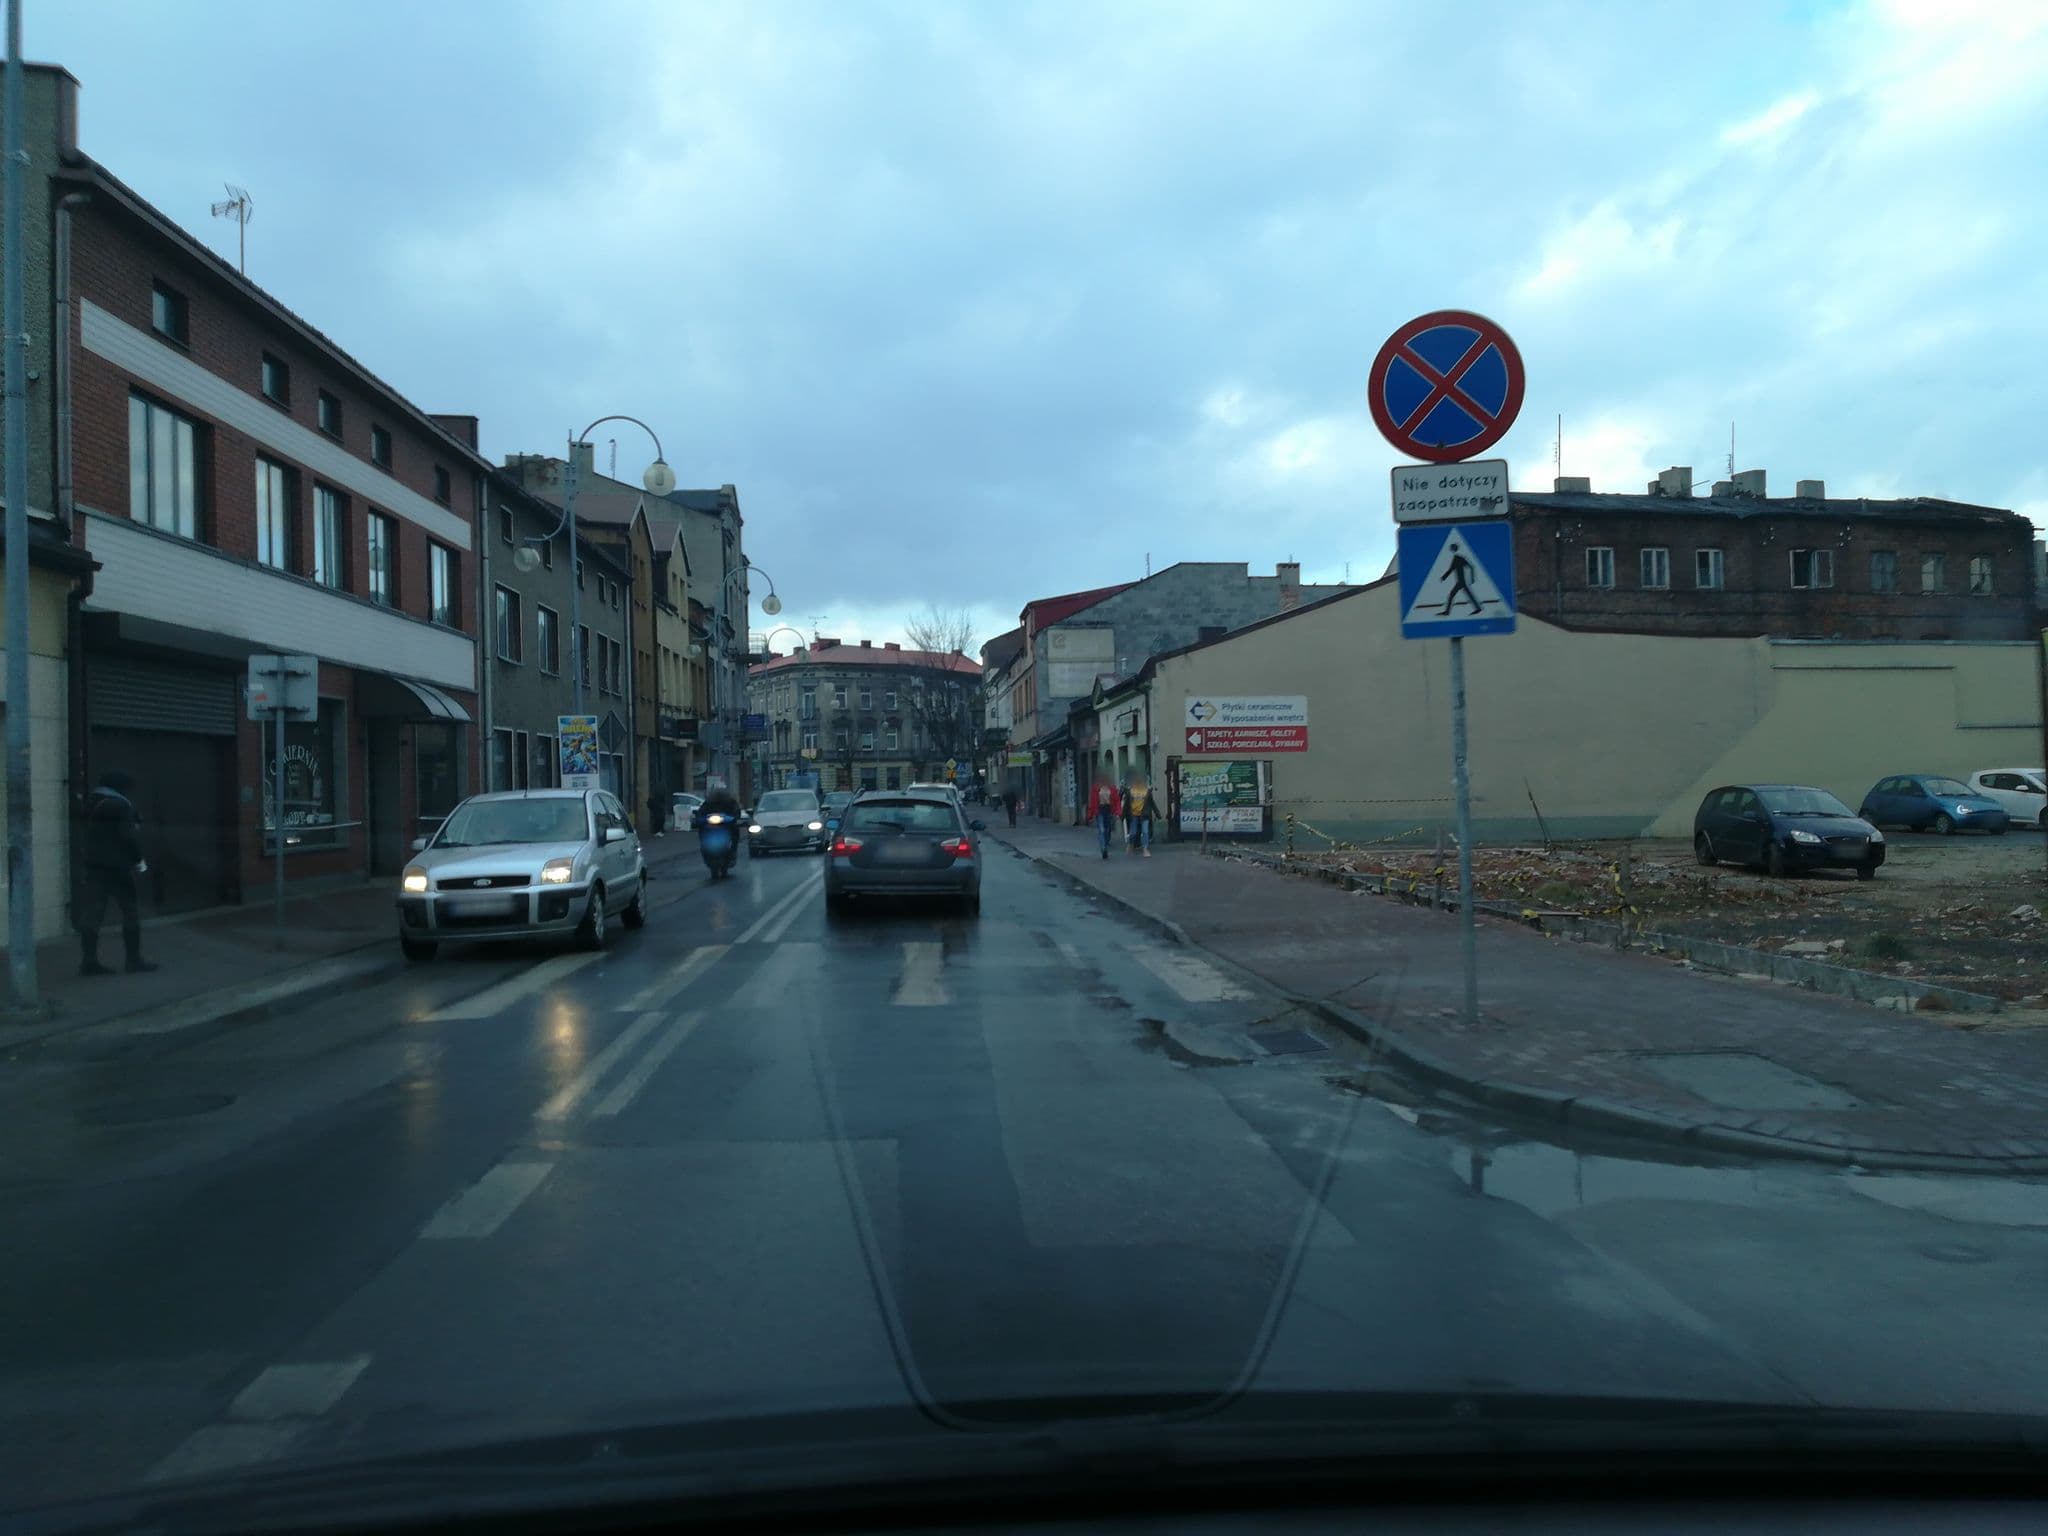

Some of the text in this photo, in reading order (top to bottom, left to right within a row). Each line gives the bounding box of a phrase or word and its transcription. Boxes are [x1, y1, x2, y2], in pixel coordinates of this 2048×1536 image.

[1402, 475, 1498, 491] Nie dotyczy
[1398, 493, 1504, 512] zaopatrzenia
[1247, 703, 1293, 711] ceramiczne
